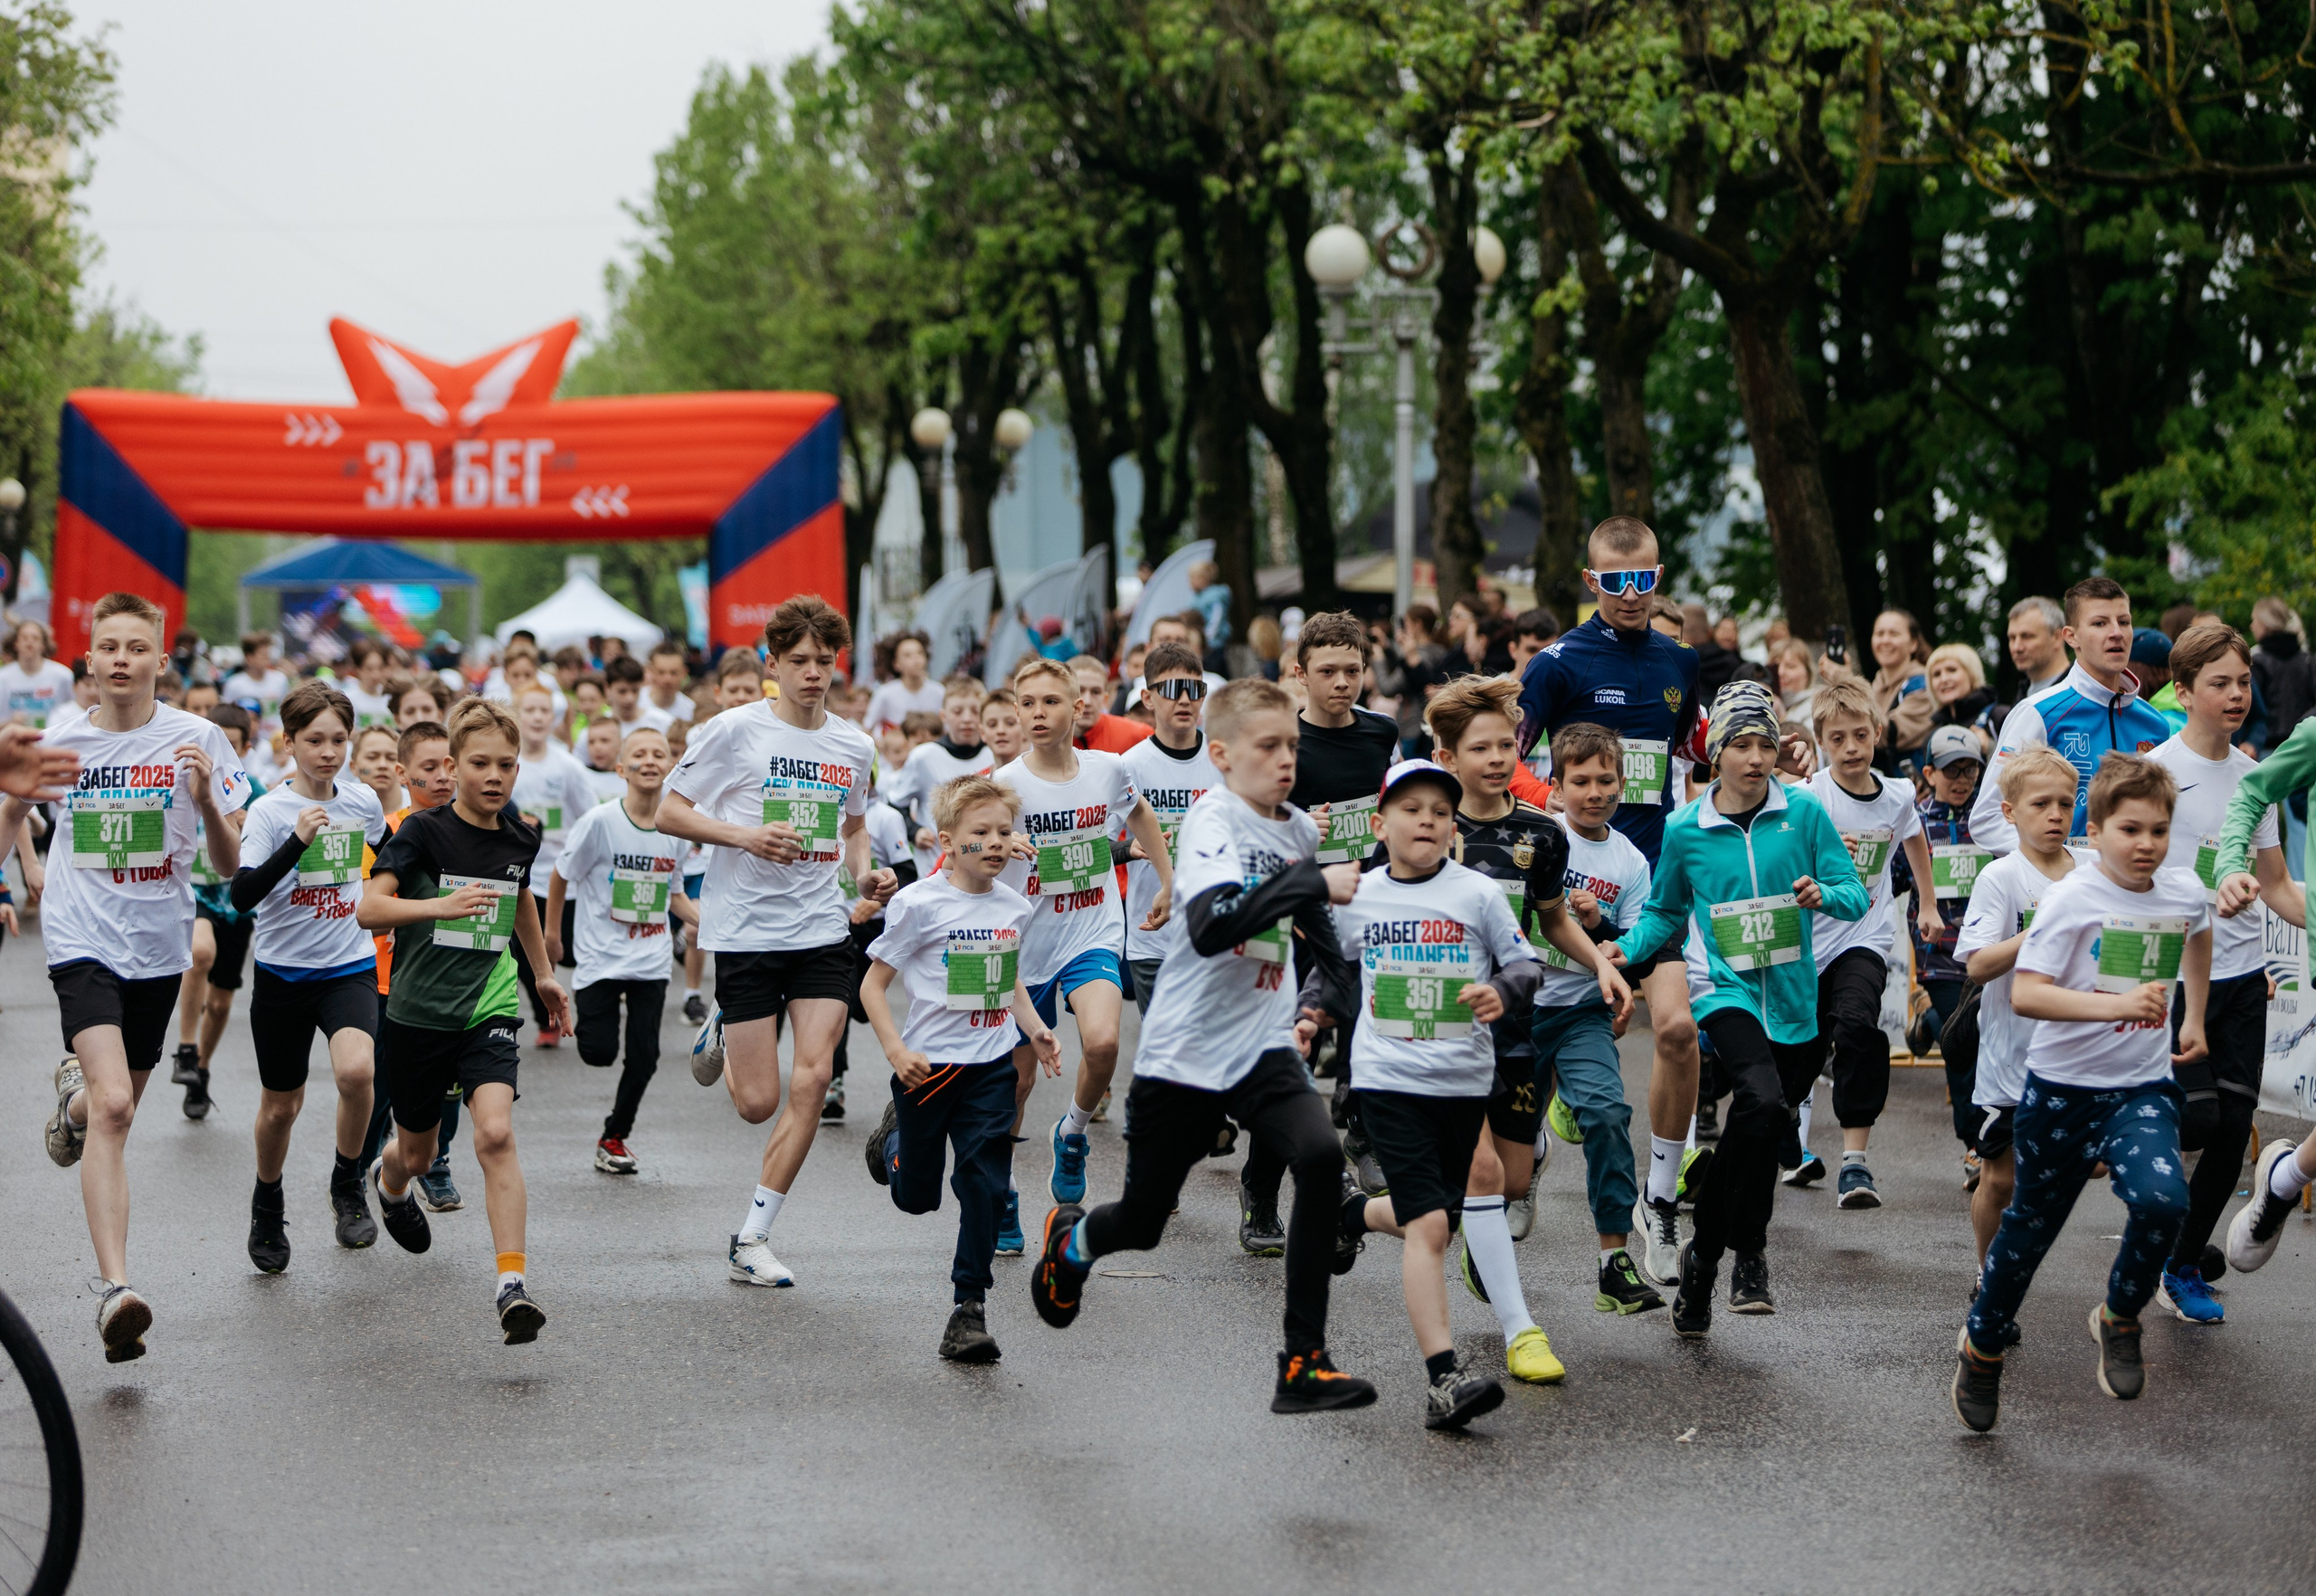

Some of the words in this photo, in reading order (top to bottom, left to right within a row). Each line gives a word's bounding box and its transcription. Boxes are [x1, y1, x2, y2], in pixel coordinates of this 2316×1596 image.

[365, 440, 440, 509] ЗА
[453, 438, 555, 509] БЕГ
[1595, 689, 1626, 697] SCANIA
[1595, 695, 1627, 705] LUKOIL
[770, 756, 852, 788] #ЗАБЕГ2025
[1623, 754, 1656, 781] 098
[100, 813, 133, 842] 371
[788, 802, 819, 828] 352
[1025, 804, 1107, 835] #ЗАБЕГ2025
[1333, 810, 1372, 841] 2001
[322, 833, 351, 860] 357
[1061, 842, 1094, 870] 390
[507, 864, 526, 878] FILA
[1950, 856, 1977, 879] 280
[290, 887, 341, 906] ВМЕСТЕ
[631, 882, 657, 905] 368
[1563, 869, 1621, 904] БЕГ2025
[1054, 894, 1066, 913] С
[1364, 919, 1464, 947] #ЗАБЕГ2025
[1740, 912, 1775, 943] 212
[2142, 935, 2160, 966] 74
[983, 955, 1002, 984] 10
[1405, 977, 1444, 1011] 351
[970, 1010, 980, 1027] С
[983, 1006, 1011, 1028] ТОБО
[489, 1028, 514, 1042] FILA
